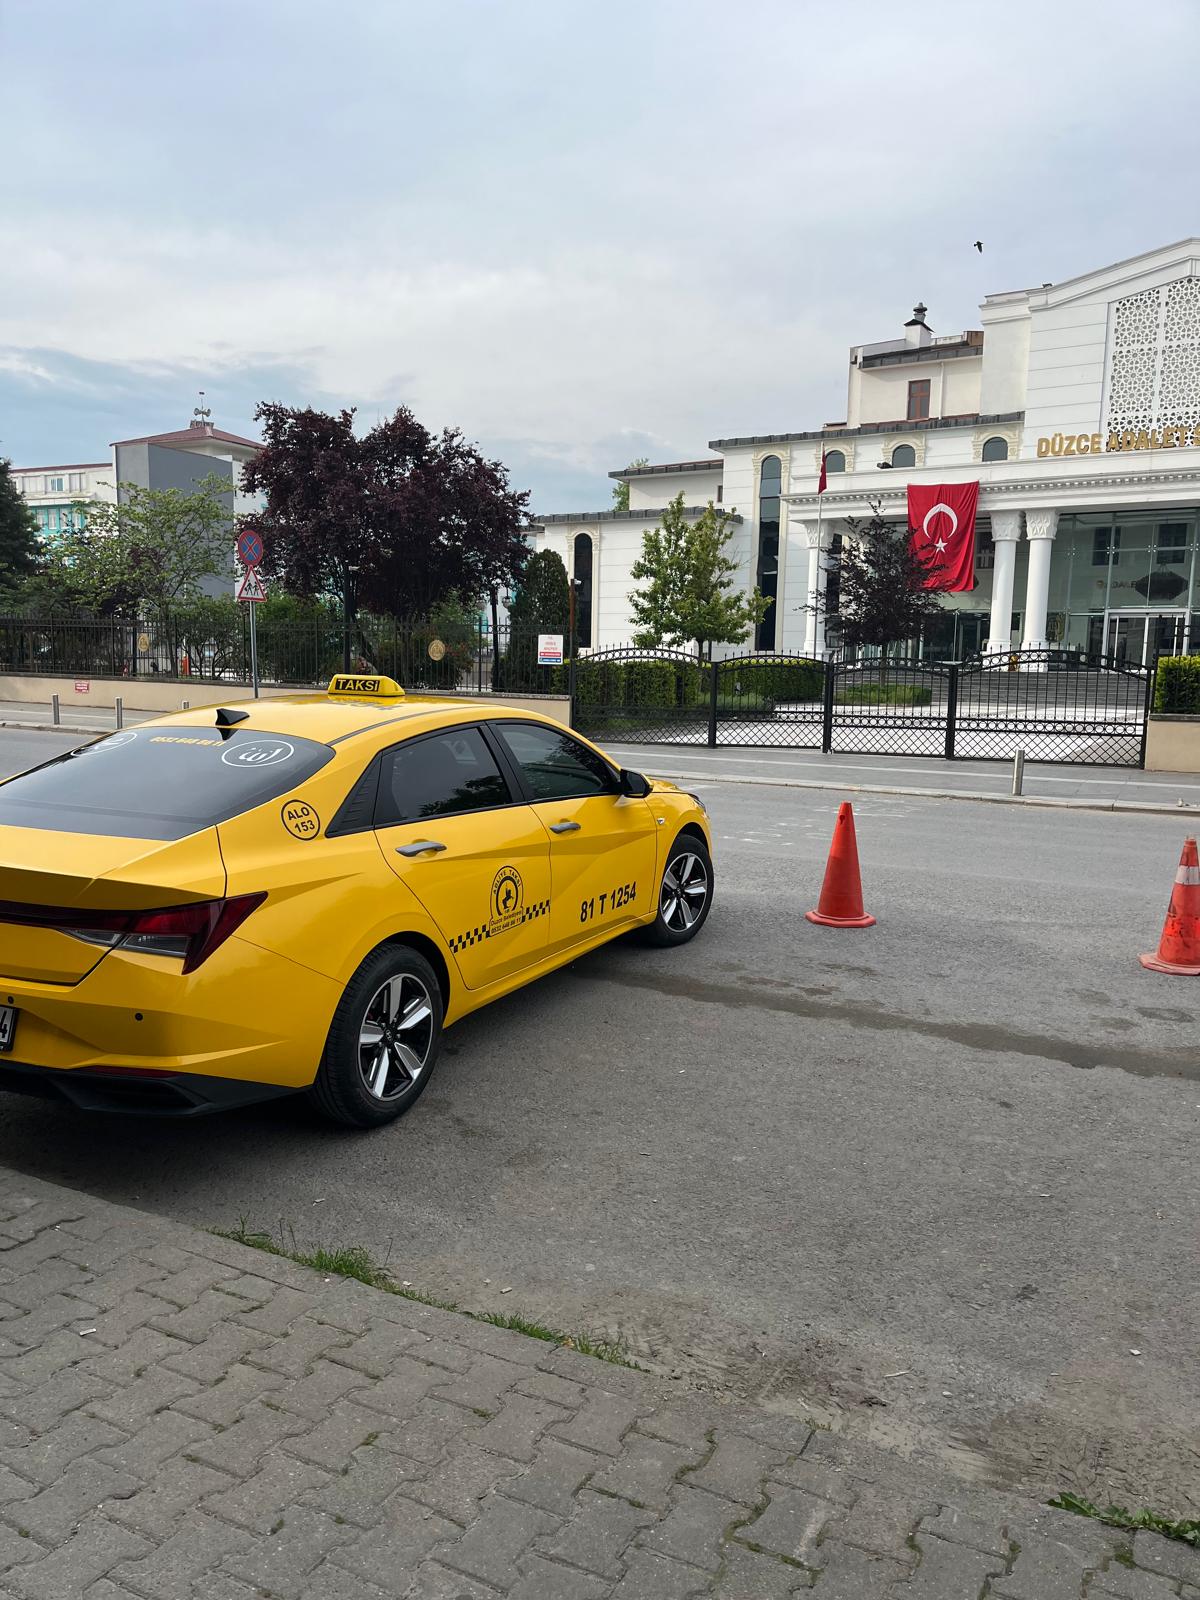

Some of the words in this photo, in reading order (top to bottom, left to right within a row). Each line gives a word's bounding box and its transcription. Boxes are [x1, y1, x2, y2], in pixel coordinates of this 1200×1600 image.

[1037, 433, 1103, 457] DÜZCE
[1106, 426, 1190, 452] ADALET
[288, 806, 310, 821] ALO
[295, 820, 315, 833] 153
[580, 897, 594, 922] 81
[599, 893, 607, 915] T
[611, 881, 636, 910] 1254
